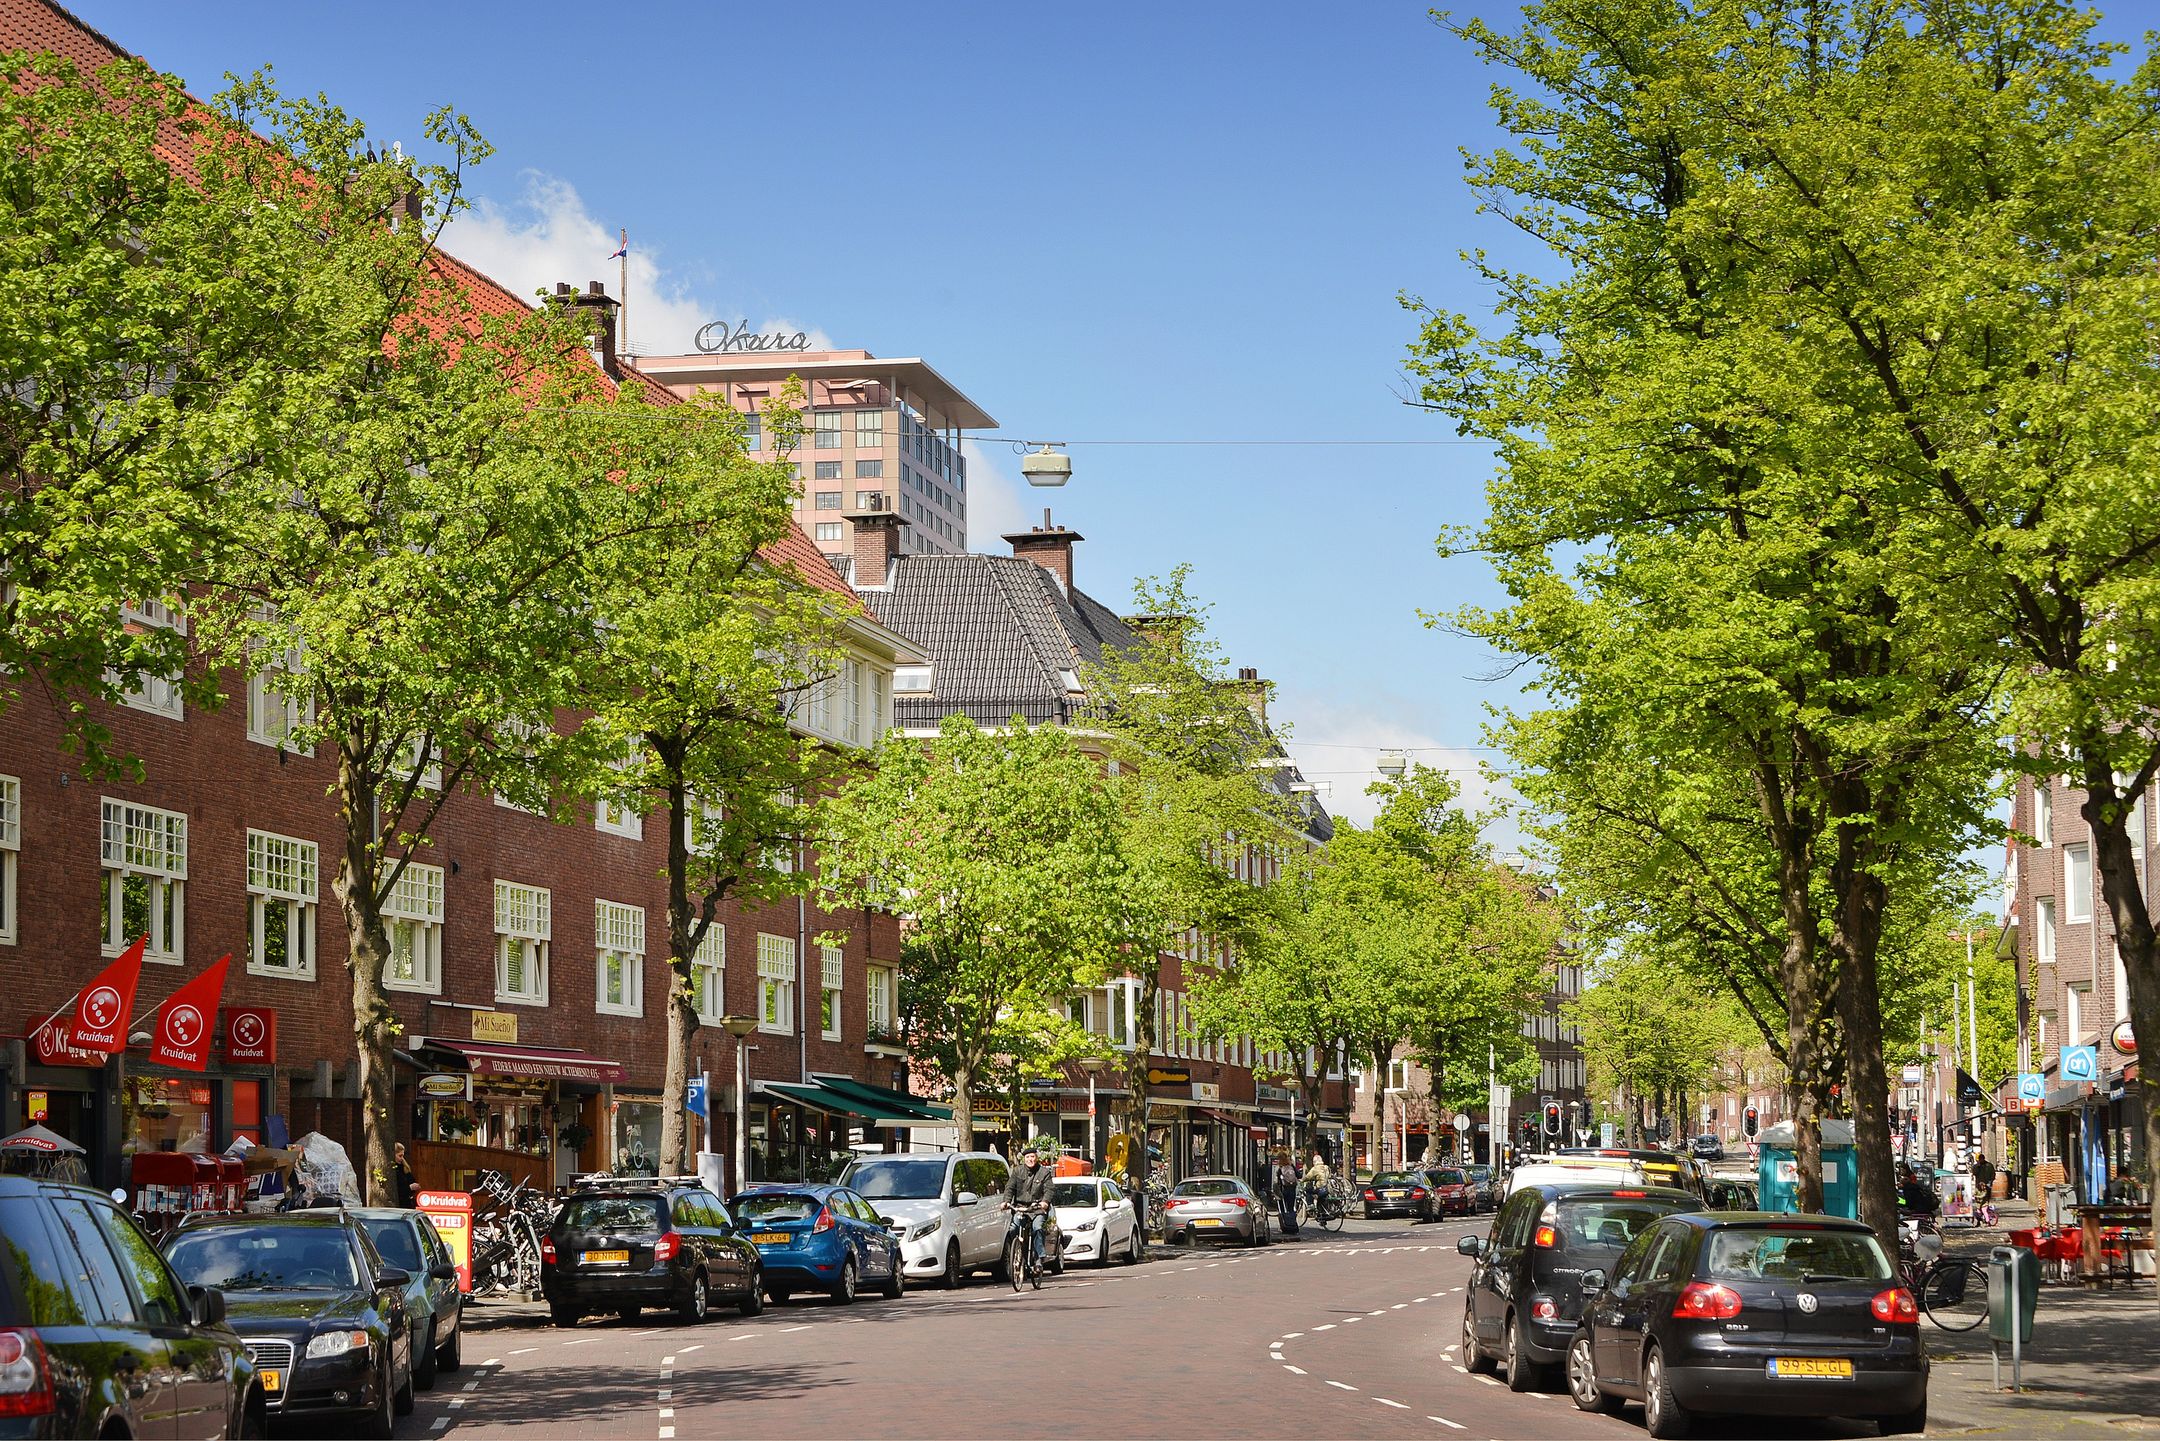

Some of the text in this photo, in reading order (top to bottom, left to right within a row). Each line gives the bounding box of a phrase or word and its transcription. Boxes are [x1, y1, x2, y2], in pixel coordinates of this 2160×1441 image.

[695, 319, 812, 352] Okura
[480, 1016, 511, 1033] Mi Sueño
[77, 1031, 114, 1043] Kruidvat
[160, 1046, 197, 1062] Kruidvat
[232, 1048, 264, 1057] Kruidvat
[492, 1060, 512, 1072] IEDERE
[512, 1062, 533, 1074] MAAND
[533, 1063, 545, 1075] EEN
[544, 1064, 561, 1076] NIEUW
[688, 1088, 698, 1104] P
[15, 1138, 53, 1149] Kruidvat
[430, 1195, 468, 1207] Kruidvat
